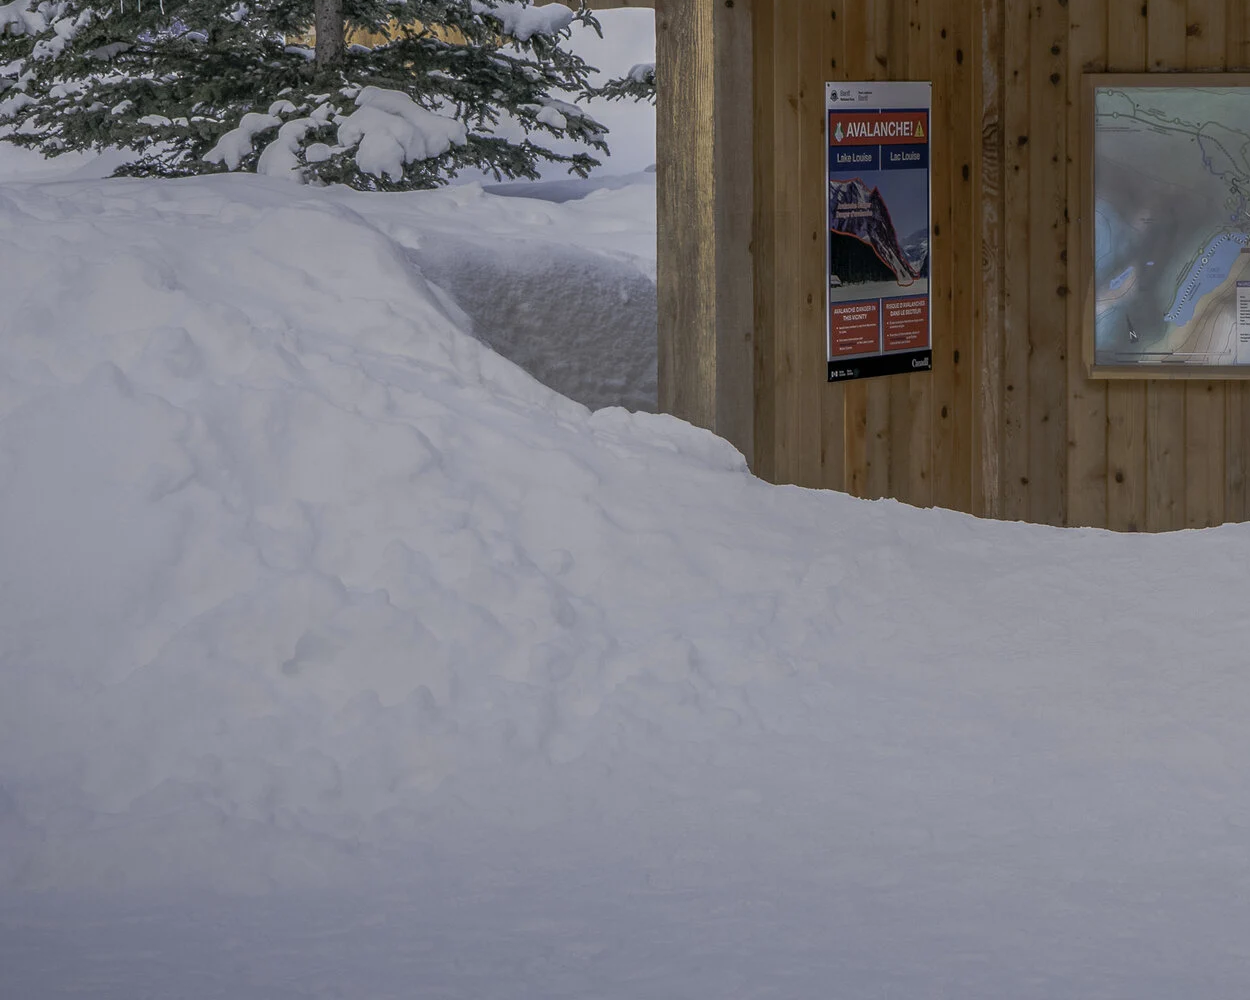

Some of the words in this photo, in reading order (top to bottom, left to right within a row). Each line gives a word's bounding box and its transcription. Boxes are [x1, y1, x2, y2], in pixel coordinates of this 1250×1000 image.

[846, 121, 913, 137] AVALANCHE!
[837, 153, 852, 163] Lake
[852, 152, 872, 162] Louise
[890, 151, 901, 161] Lac
[901, 151, 920, 161] Louise
